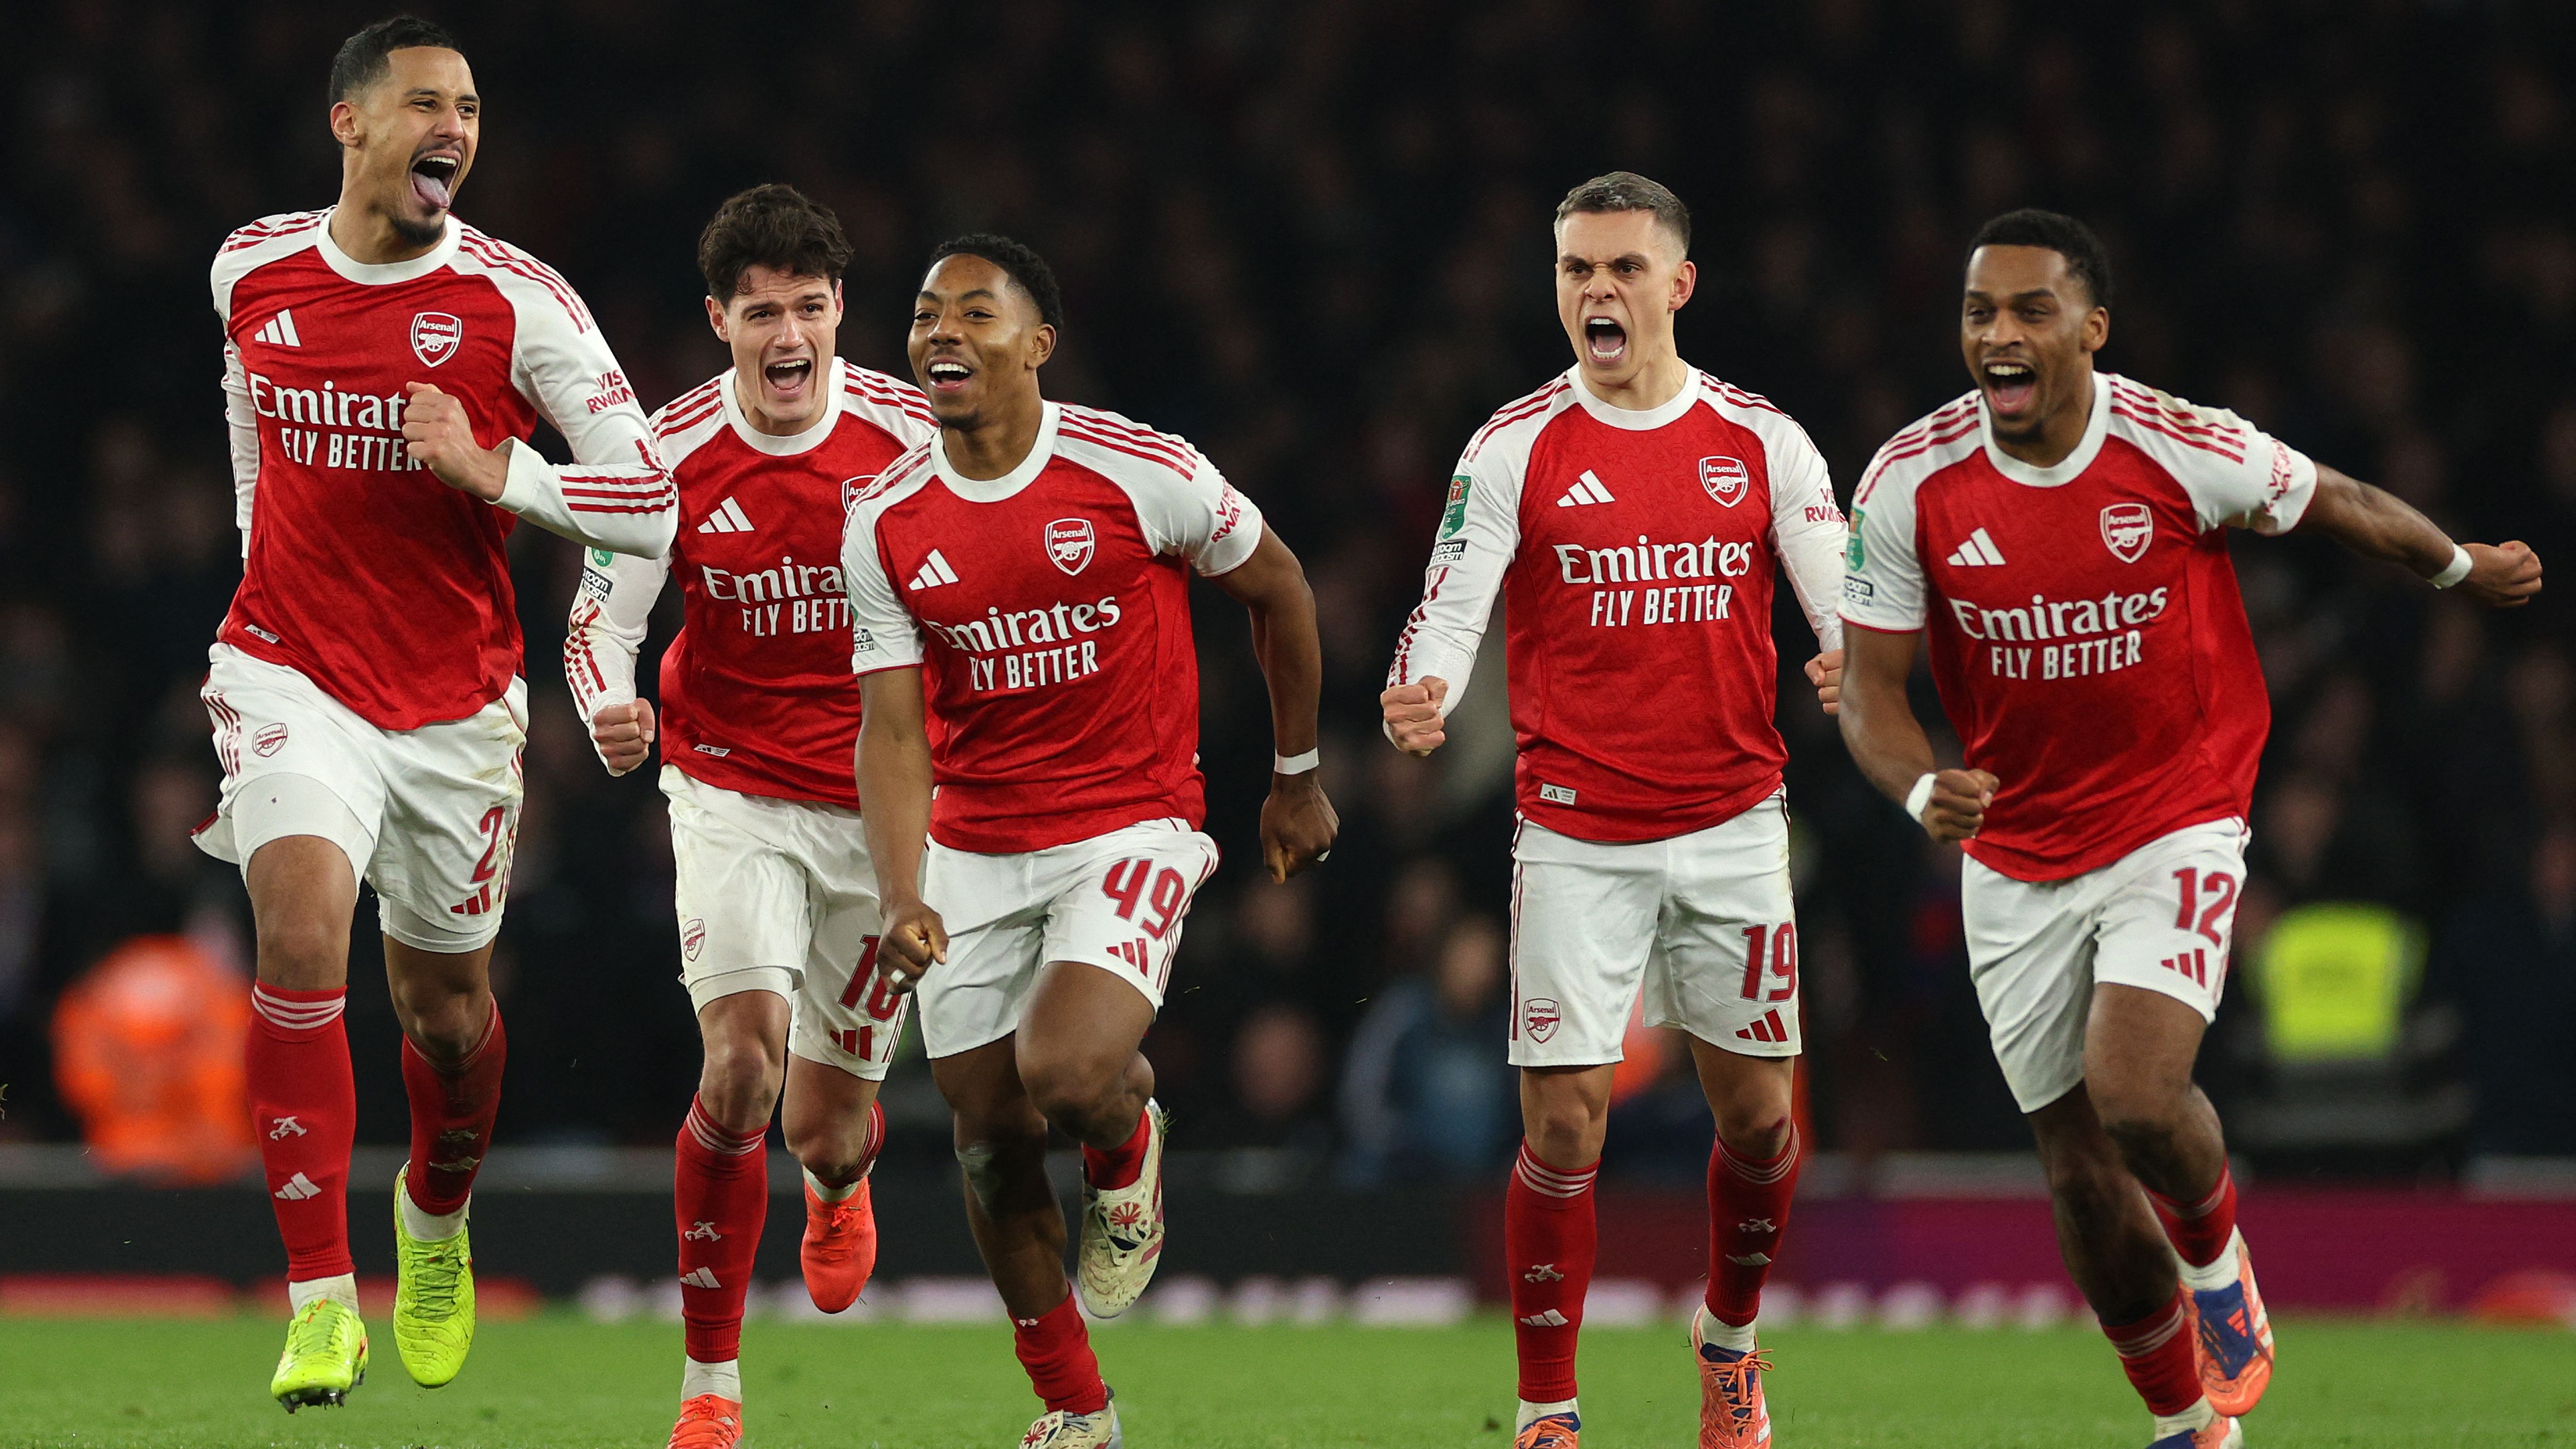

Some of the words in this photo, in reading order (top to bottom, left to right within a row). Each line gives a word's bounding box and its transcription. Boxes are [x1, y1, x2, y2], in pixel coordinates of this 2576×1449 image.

[419, 320, 454, 332] Arsenal
[250, 372, 406, 431] Emirat
[586, 387, 637, 414] RWAN
[596, 369, 623, 391] VIS
[281, 428, 318, 465] FLY
[1707, 465, 1740, 473] Arsenal
[1052, 527, 1087, 539] Arsenal
[1437, 543, 1462, 554] room
[585, 570, 609, 591] room
[701, 556, 847, 605] Emira
[1552, 534, 1753, 584] Emirates
[742, 603, 781, 637] FLY
[792, 598, 850, 634] BETT
[921, 596, 1121, 653] Emirates
[1590, 590, 1634, 627] FLY
[1643, 585, 1733, 625] BETTER
[1948, 586, 2168, 641] Emirates
[1005, 640, 1099, 689] BETTER
[1991, 646, 2032, 680] FLY
[2043, 629, 2142, 680] BETTER
[470, 805, 505, 883] 2
[1100, 858, 1185, 942] 49
[2172, 863, 2236, 949] 12
[1740, 920, 1796, 1002] 19
